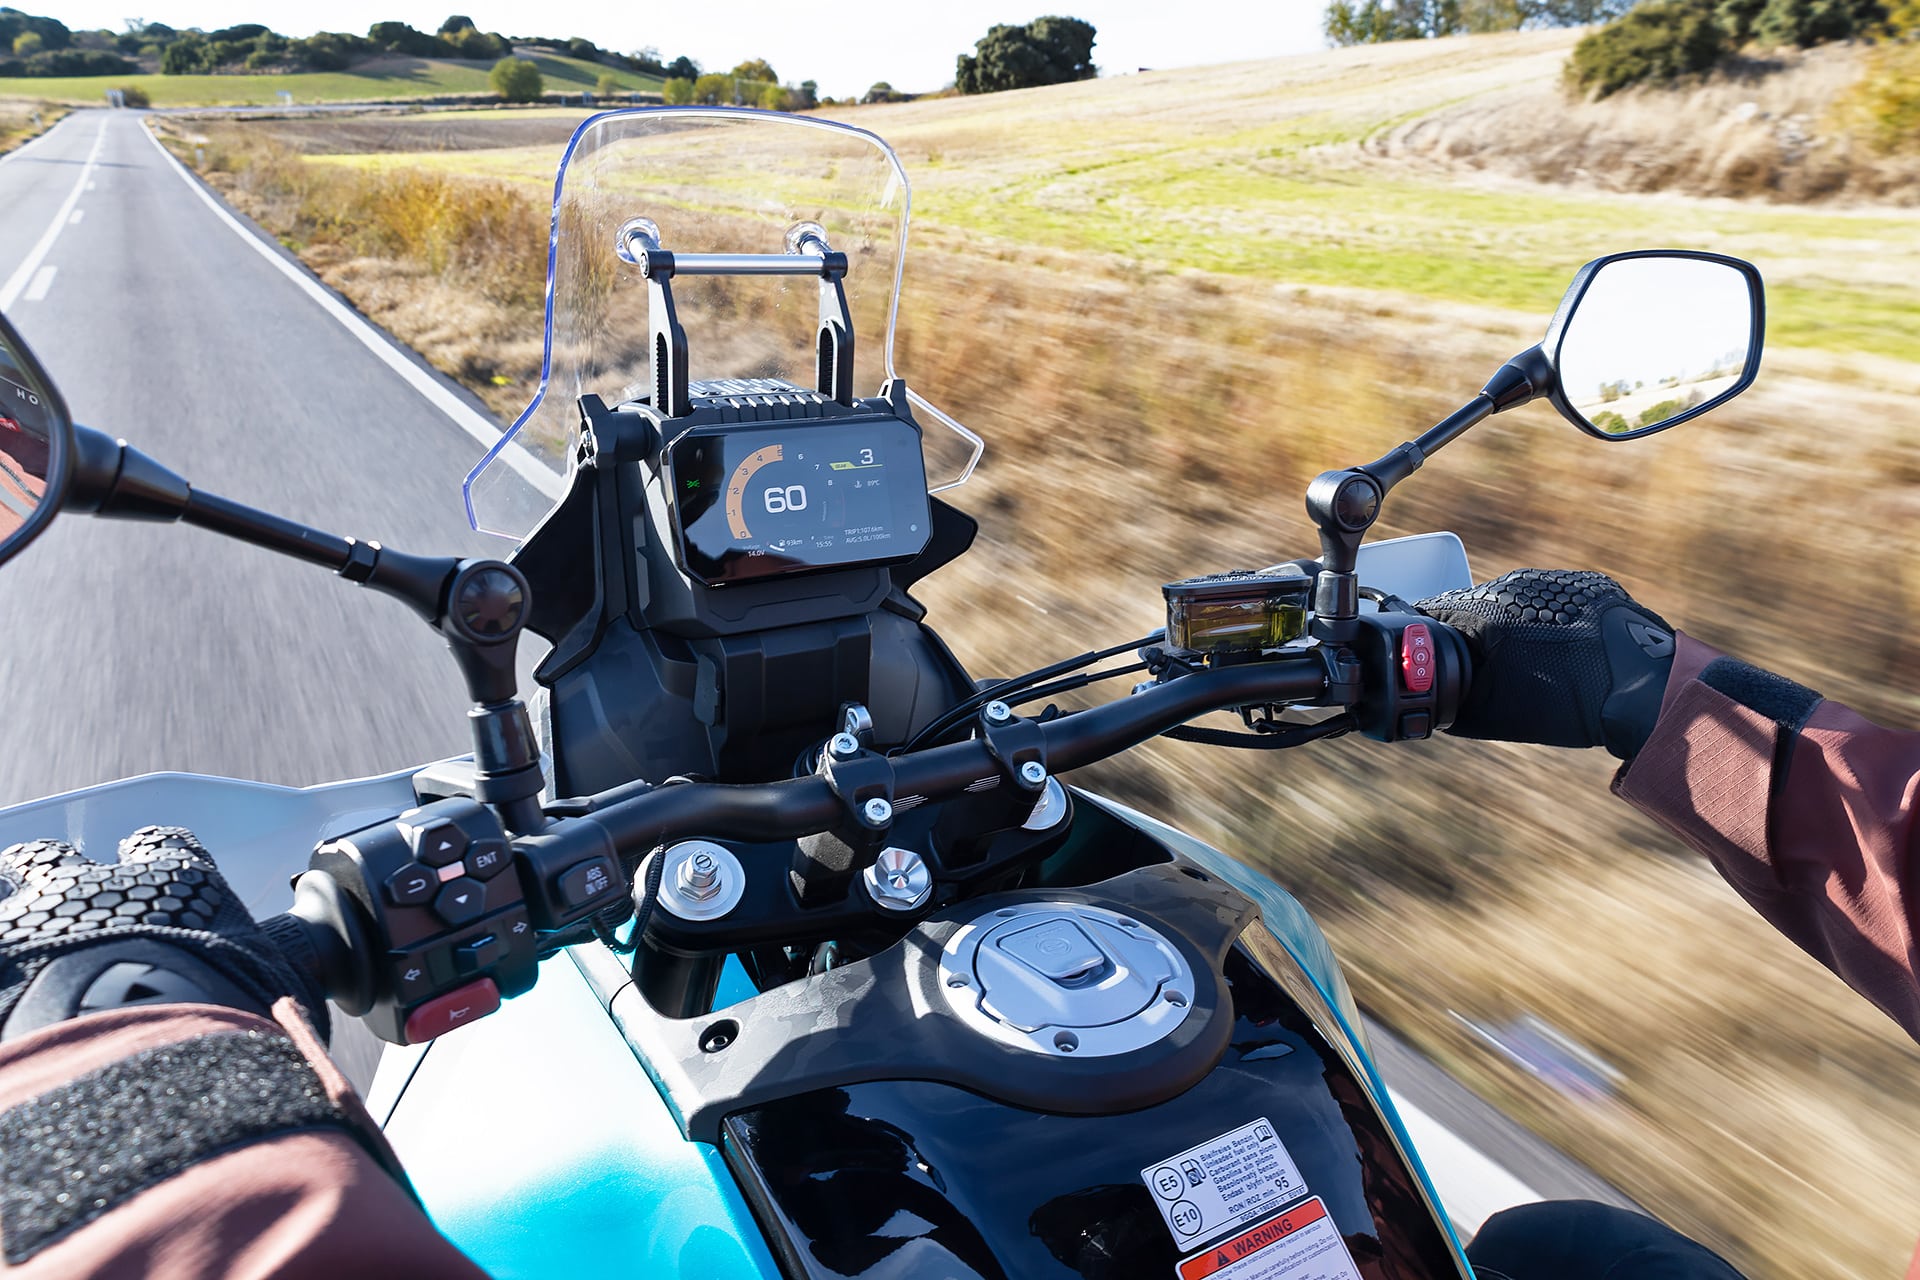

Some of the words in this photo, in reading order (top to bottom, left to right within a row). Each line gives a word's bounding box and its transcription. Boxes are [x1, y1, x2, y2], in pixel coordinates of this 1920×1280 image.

[756, 454, 763, 462] 4
[798, 453, 804, 461] 6
[860, 448, 874, 465] 3
[742, 468, 749, 476] 3
[814, 464, 820, 472] 7
[733, 487, 740, 495] 2
[764, 485, 807, 513] 60
[815, 540, 833, 548] 15:55
[476, 851, 497, 868] ENT
[586, 866, 602, 882] ABS
[595, 876, 608, 890] OFF
[1200, 1144, 1231, 1162] Bleifreies
[1231, 1135, 1254, 1148] Benzin
[1204, 1153, 1233, 1169] Unleaded
[1233, 1146, 1246, 1157] fuel
[1246, 1141, 1260, 1152] only
[1209, 1159, 1242, 1177] Carburant
[1242, 1152, 1258, 1162] sans
[1259, 1142, 1278, 1156] plomb
[1257, 1160, 1279, 1174] benzin
[1213, 1168, 1243, 1184] Gasolina
[1243, 1162, 1254, 1171] sin
[1255, 1154, 1274, 1167] plomo
[1159, 1175, 1178, 1192] E5
[1221, 1187, 1245, 1202] Endast
[1245, 1178, 1264, 1191] blyfri
[1264, 1168, 1286, 1181] bensin
[1228, 1193, 1261, 1215] RON/ROZ
[1274, 1176, 1290, 1191] 95
[1174, 1208, 1198, 1228] E10
[1232, 1218, 1293, 1256] WARNING
[1216, 1269, 1232, 1279] follow
[1232, 1261, 1247, 1272] these
[1247, 1246, 1275, 1264] instructions
[1275, 1242, 1287, 1252] may
[1286, 1234, 1301, 1245] result
[1304, 1224, 1321, 1236] serious
[1249, 1266, 1269, 1279] Manual
[1269, 1257, 1290, 1271] carefully
[1289, 1248, 1305, 1261] before
[1318, 1237, 1327, 1245] Do
[1272, 1258, 1302, 1277] modification
